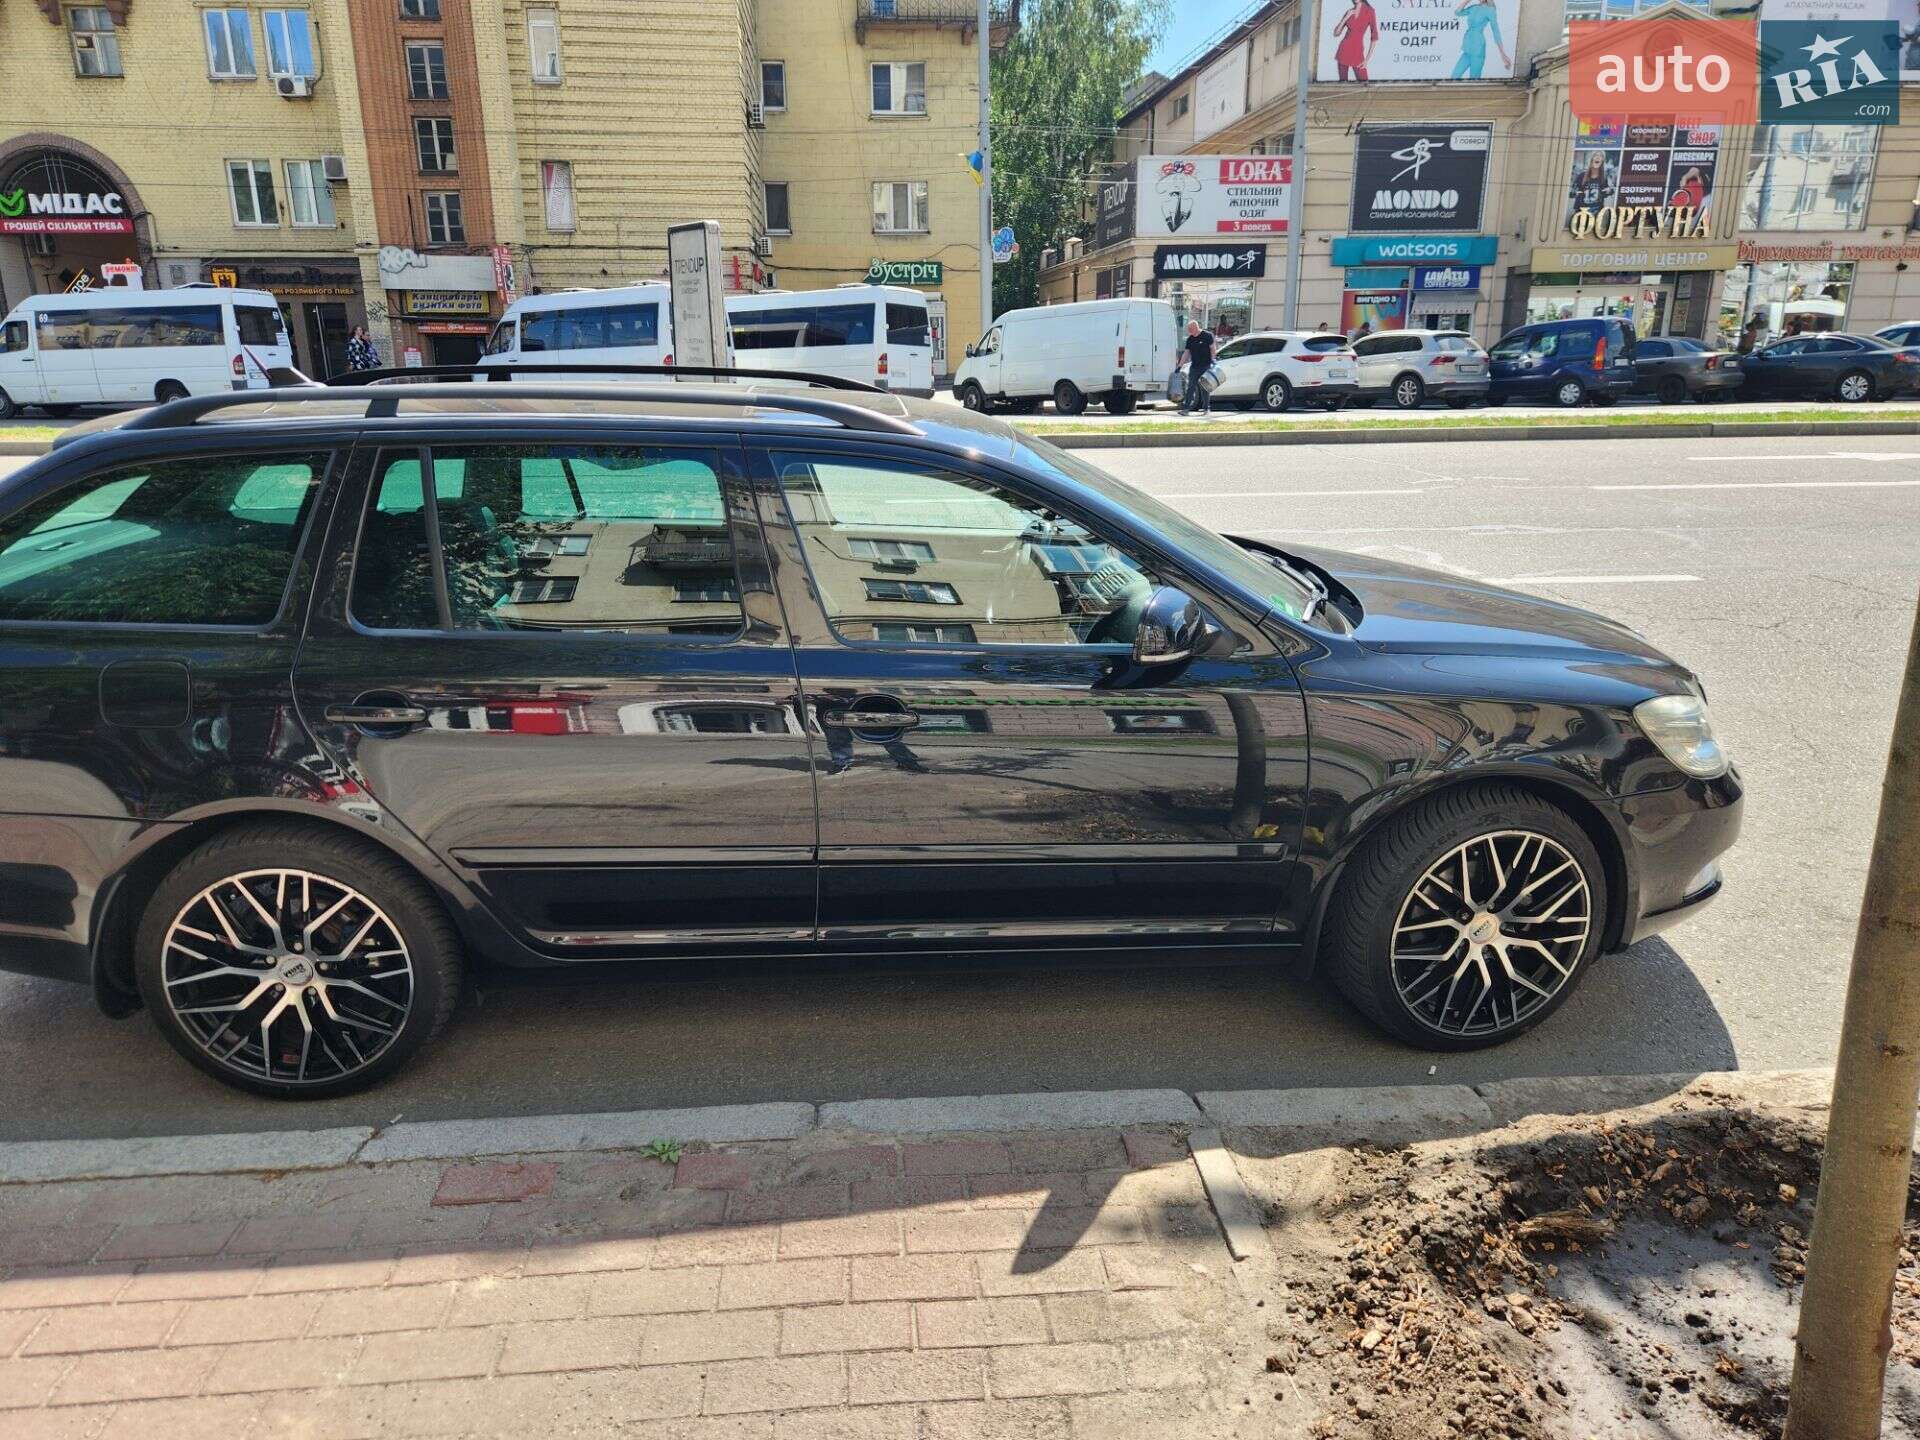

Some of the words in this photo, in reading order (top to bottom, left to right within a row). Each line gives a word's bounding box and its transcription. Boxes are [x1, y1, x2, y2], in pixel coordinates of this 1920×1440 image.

[1380, 18, 1460, 32] МЕДИЧНИЙ
[1400, 36, 1437, 47] ОДЯГ
[1392, 53, 1400, 63] 3
[1403, 54, 1442, 64] поверх
[1687, 131, 1716, 145] SHOP
[1633, 153, 1659, 162] ДЕКОР
[1228, 161, 1283, 181] LORA
[1631, 164, 1657, 172] ПОСУД
[1227, 187, 1282, 196] СТИЛЬНИЙ
[28, 192, 123, 213] МІДАС
[1229, 198, 1280, 207] ЖІНОЧИЙ
[1371, 189, 1459, 210] MONDO
[1625, 196, 1655, 204] ТОВАРИ
[1240, 209, 1267, 218] ОДЯГ
[4, 220, 46, 230] ГРОШЕЙ
[46, 221, 91, 230] СКІЛЬКИ
[91, 222, 124, 230] ТРЕБА
[1233, 222, 1240, 231] 3
[1242, 223, 1272, 232] поверх
[1570, 205, 1712, 240] ФОРТУНА
[1379, 243, 1458, 257] watsons
[1163, 253, 1236, 270] MONDO
[1561, 251, 1649, 267] ТОРГОВИЙ
[1654, 252, 1709, 268] ЦЕНТР
[868, 256, 938, 285] Зустріч
[1424, 268, 1470, 282] LAVAZZA
[39, 313, 48, 323] 69
